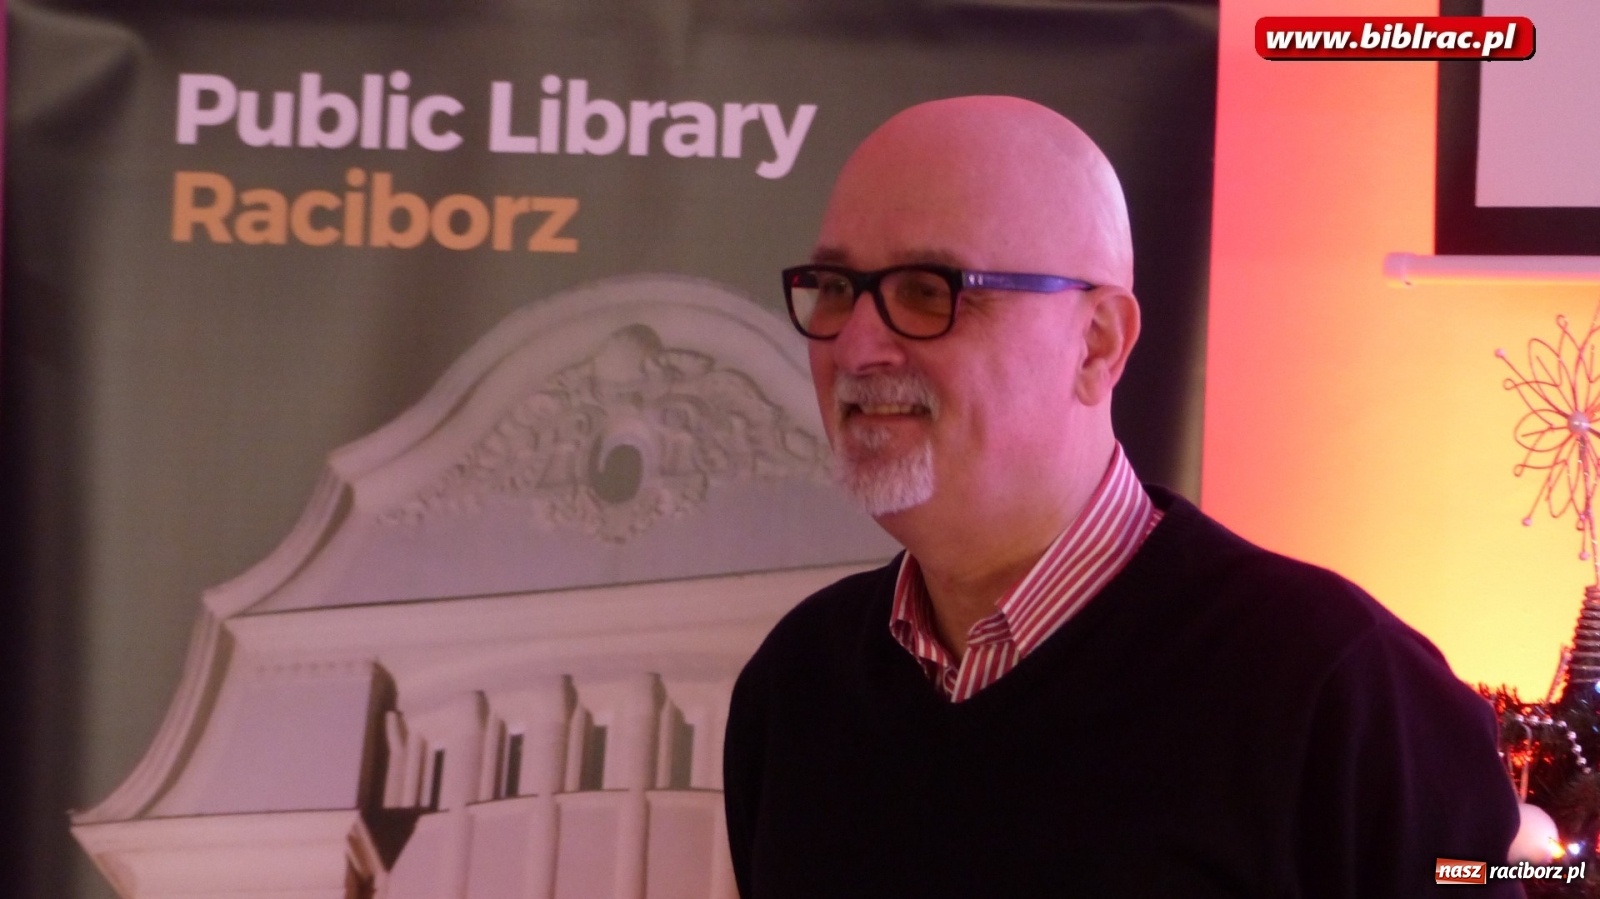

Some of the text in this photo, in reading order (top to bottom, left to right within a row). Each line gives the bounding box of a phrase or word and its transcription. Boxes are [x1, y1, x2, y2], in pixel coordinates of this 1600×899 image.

[176, 70, 818, 180] Public Library
[171, 167, 579, 253] Raciborz
